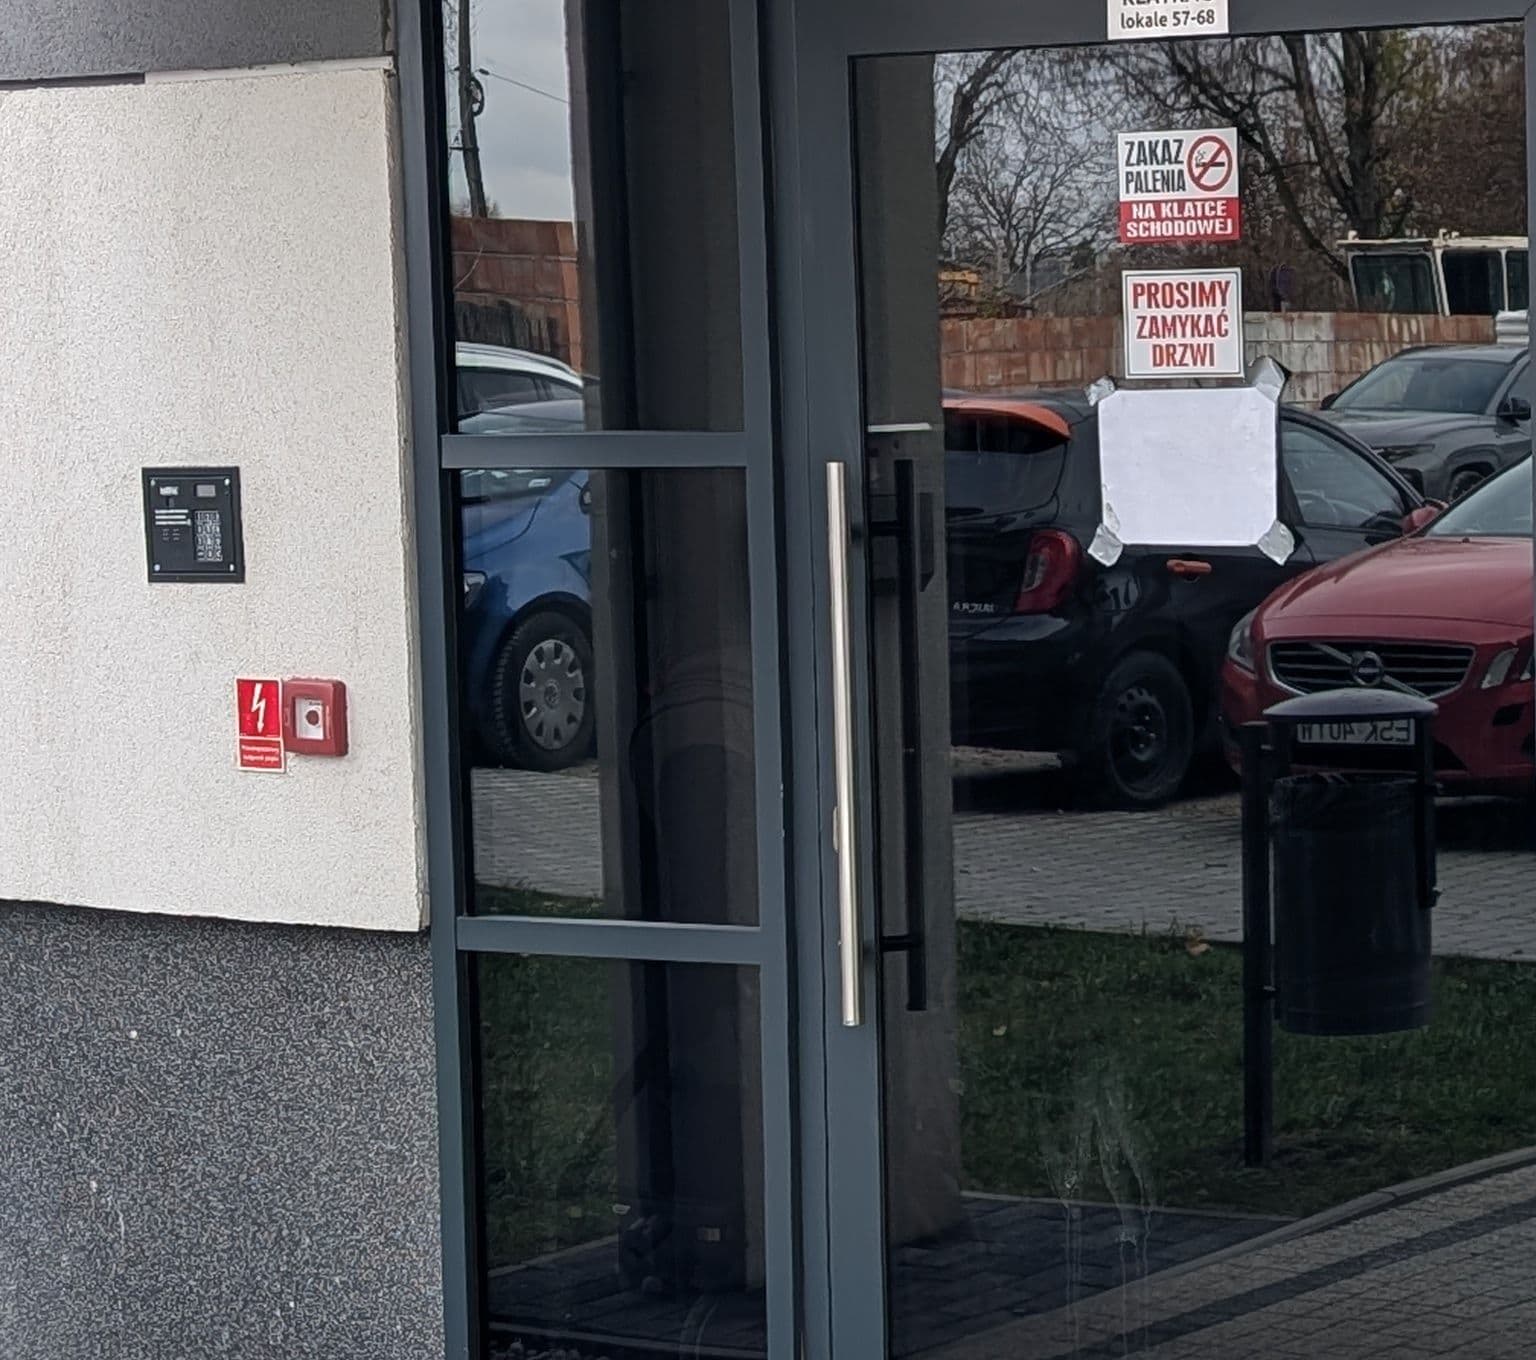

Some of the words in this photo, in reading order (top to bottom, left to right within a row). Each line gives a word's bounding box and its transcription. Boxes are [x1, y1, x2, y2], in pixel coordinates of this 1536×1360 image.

[1120, 11, 1168, 29] lokale
[1172, 9, 1216, 27] 57-68
[1124, 138, 1185, 167] ZAKAZ
[1125, 168, 1187, 194] PALENIA
[1131, 202, 1156, 220] NA
[1160, 200, 1228, 218] KLATCE
[1126, 218, 1233, 238] SCHODOWEJ
[1132, 280, 1232, 310] PROSIMY
[1136, 308, 1229, 340] ZAMYKAĆ
[1151, 342, 1216, 368] DRZWI
